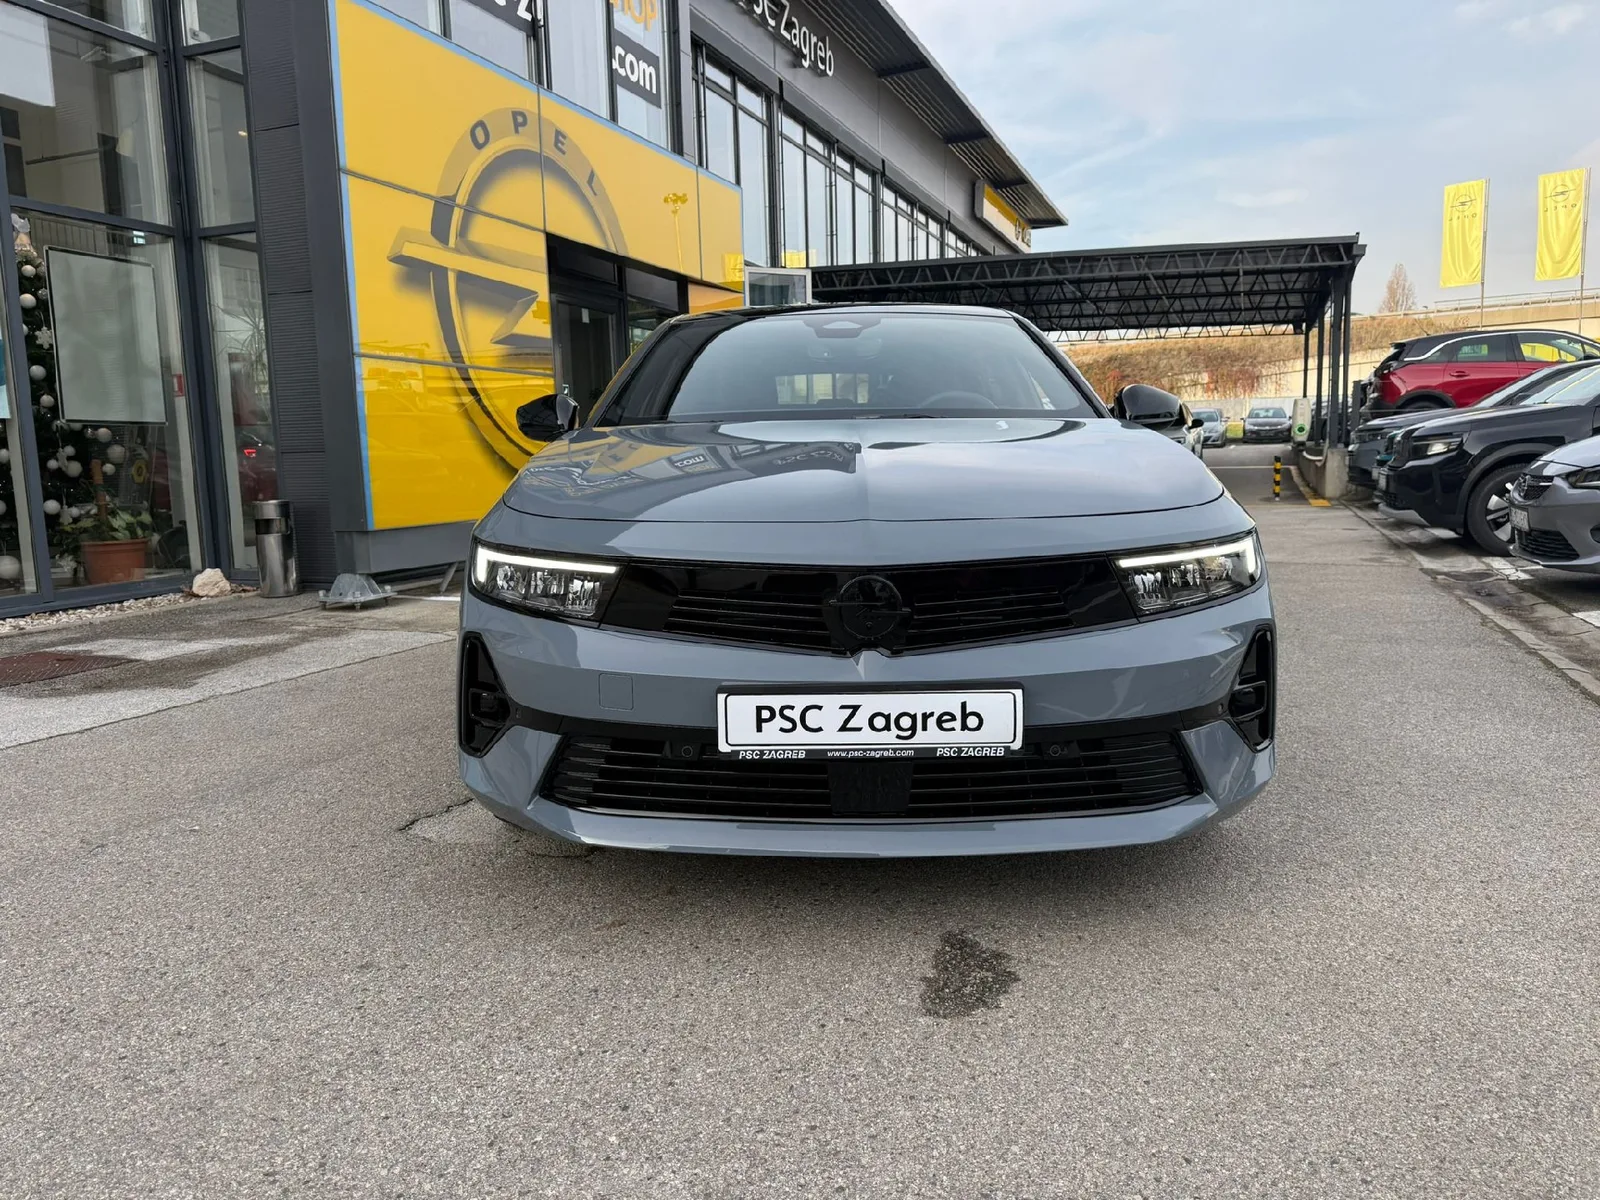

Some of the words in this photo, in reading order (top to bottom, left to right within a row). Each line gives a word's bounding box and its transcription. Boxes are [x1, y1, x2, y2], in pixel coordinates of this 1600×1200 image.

[780, 0, 834, 77] Zagreb
[612, 45, 657, 94] .com
[469, 110, 598, 196] OPEL
[755, 704, 823, 733] PSC
[837, 701, 984, 740] Zagreb
[739, 750, 760, 759] PSC
[763, 750, 806, 759] ZAGREB
[827, 748, 914, 758] www.psc-zagreb.com
[936, 747, 958, 757] PSC
[960, 747, 1005, 757] ZAGREB
